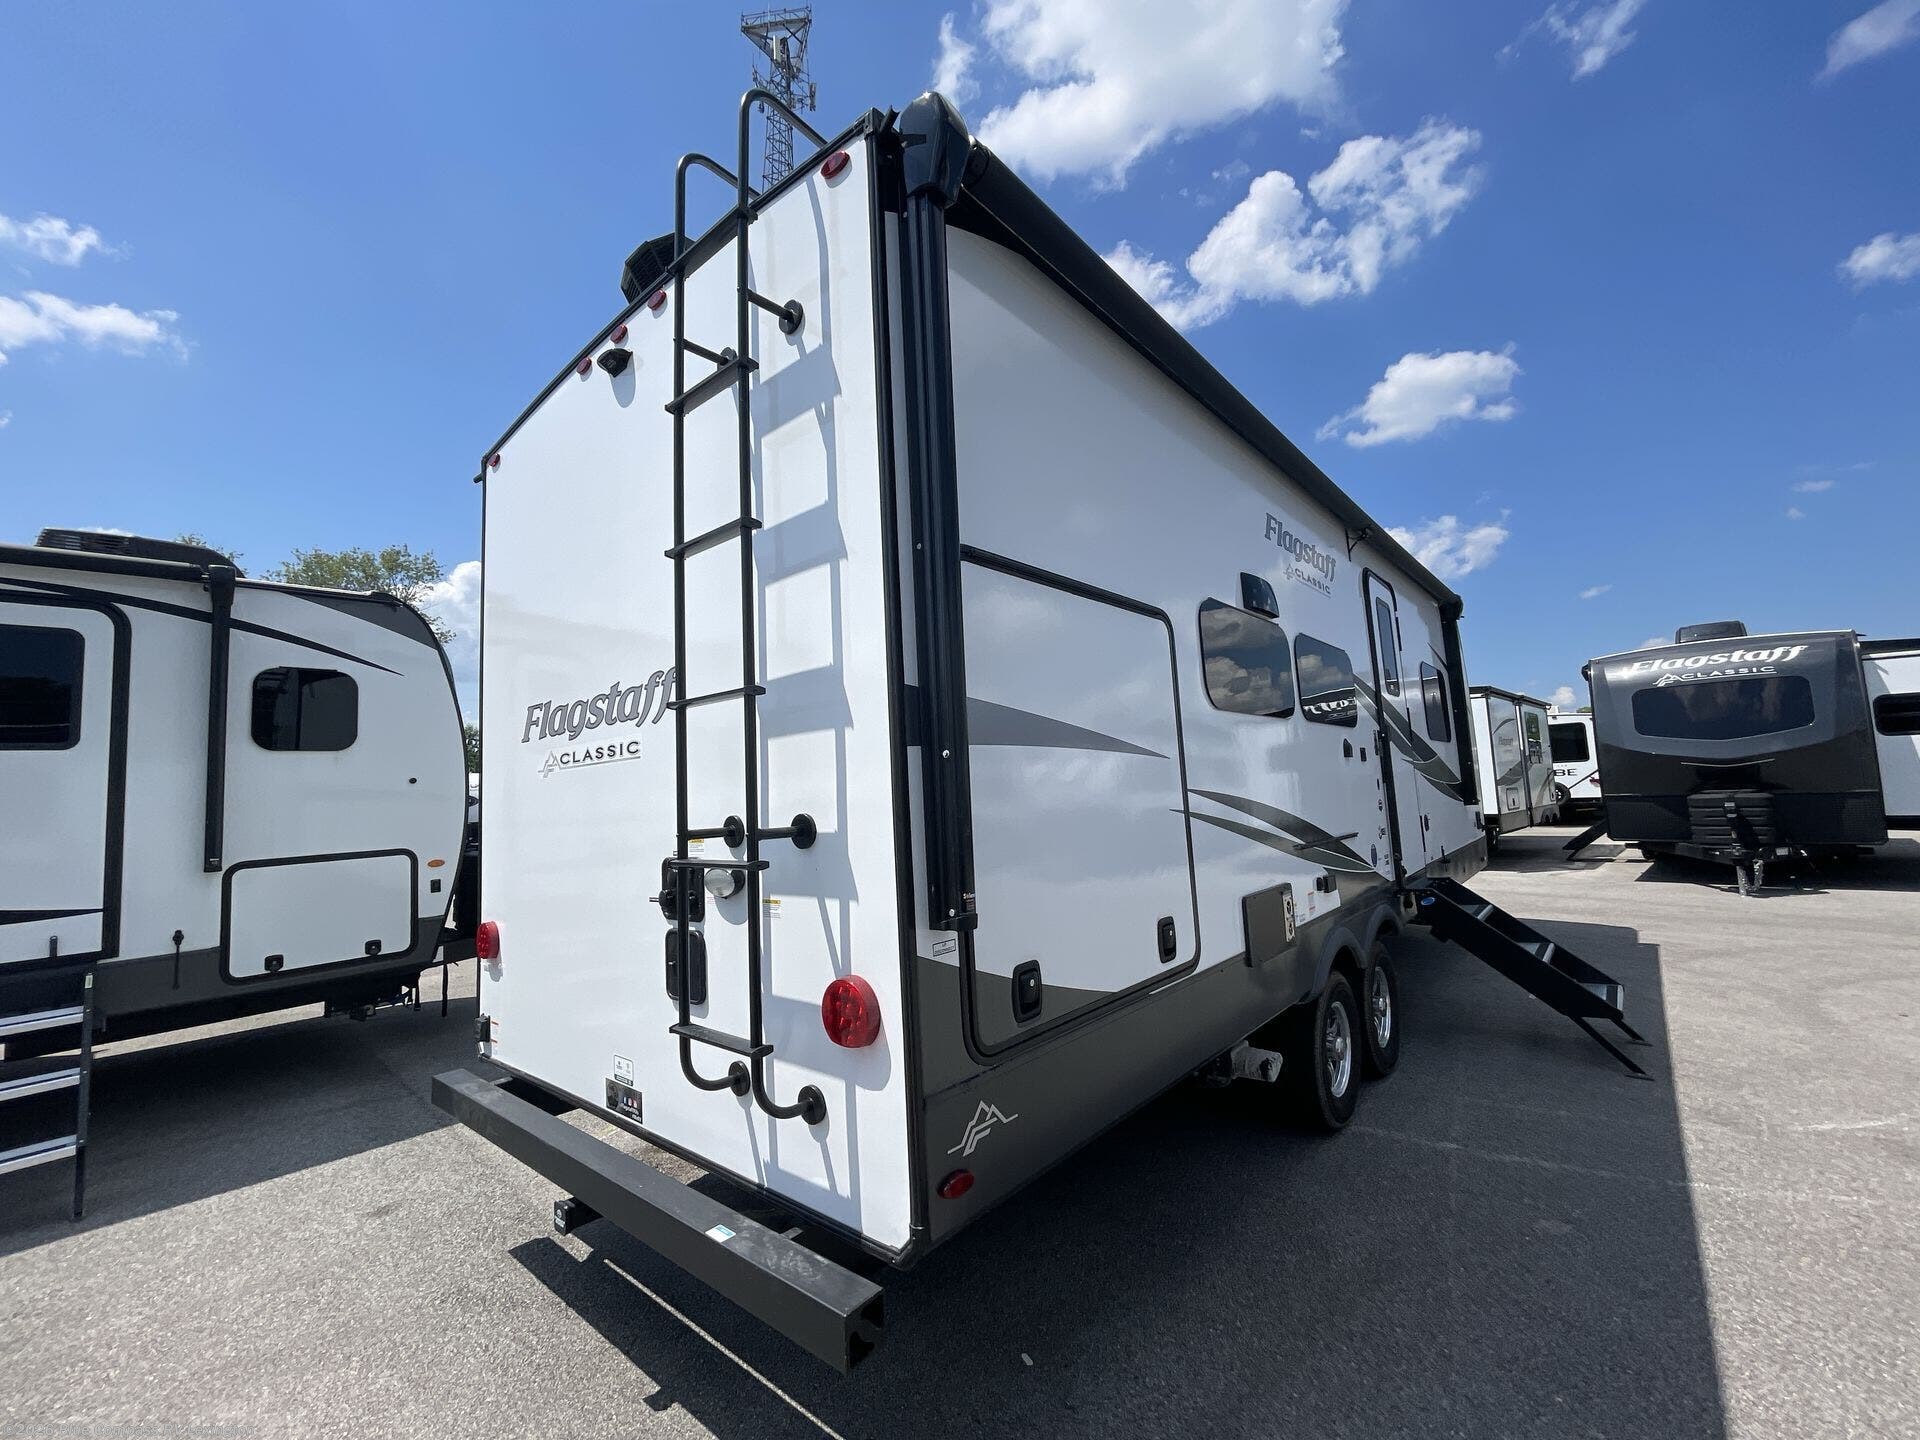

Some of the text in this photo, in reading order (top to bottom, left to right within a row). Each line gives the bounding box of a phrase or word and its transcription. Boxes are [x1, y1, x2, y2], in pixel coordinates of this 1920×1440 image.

[1264, 512, 1336, 582] Flagstaff
[1294, 569, 1332, 595] CLASSIC
[1630, 645, 1809, 673] Flagstaff
[1682, 666, 1776, 680] CLASSIC
[520, 666, 676, 744] Flagstaff
[559, 741, 640, 765] CLASSIC
